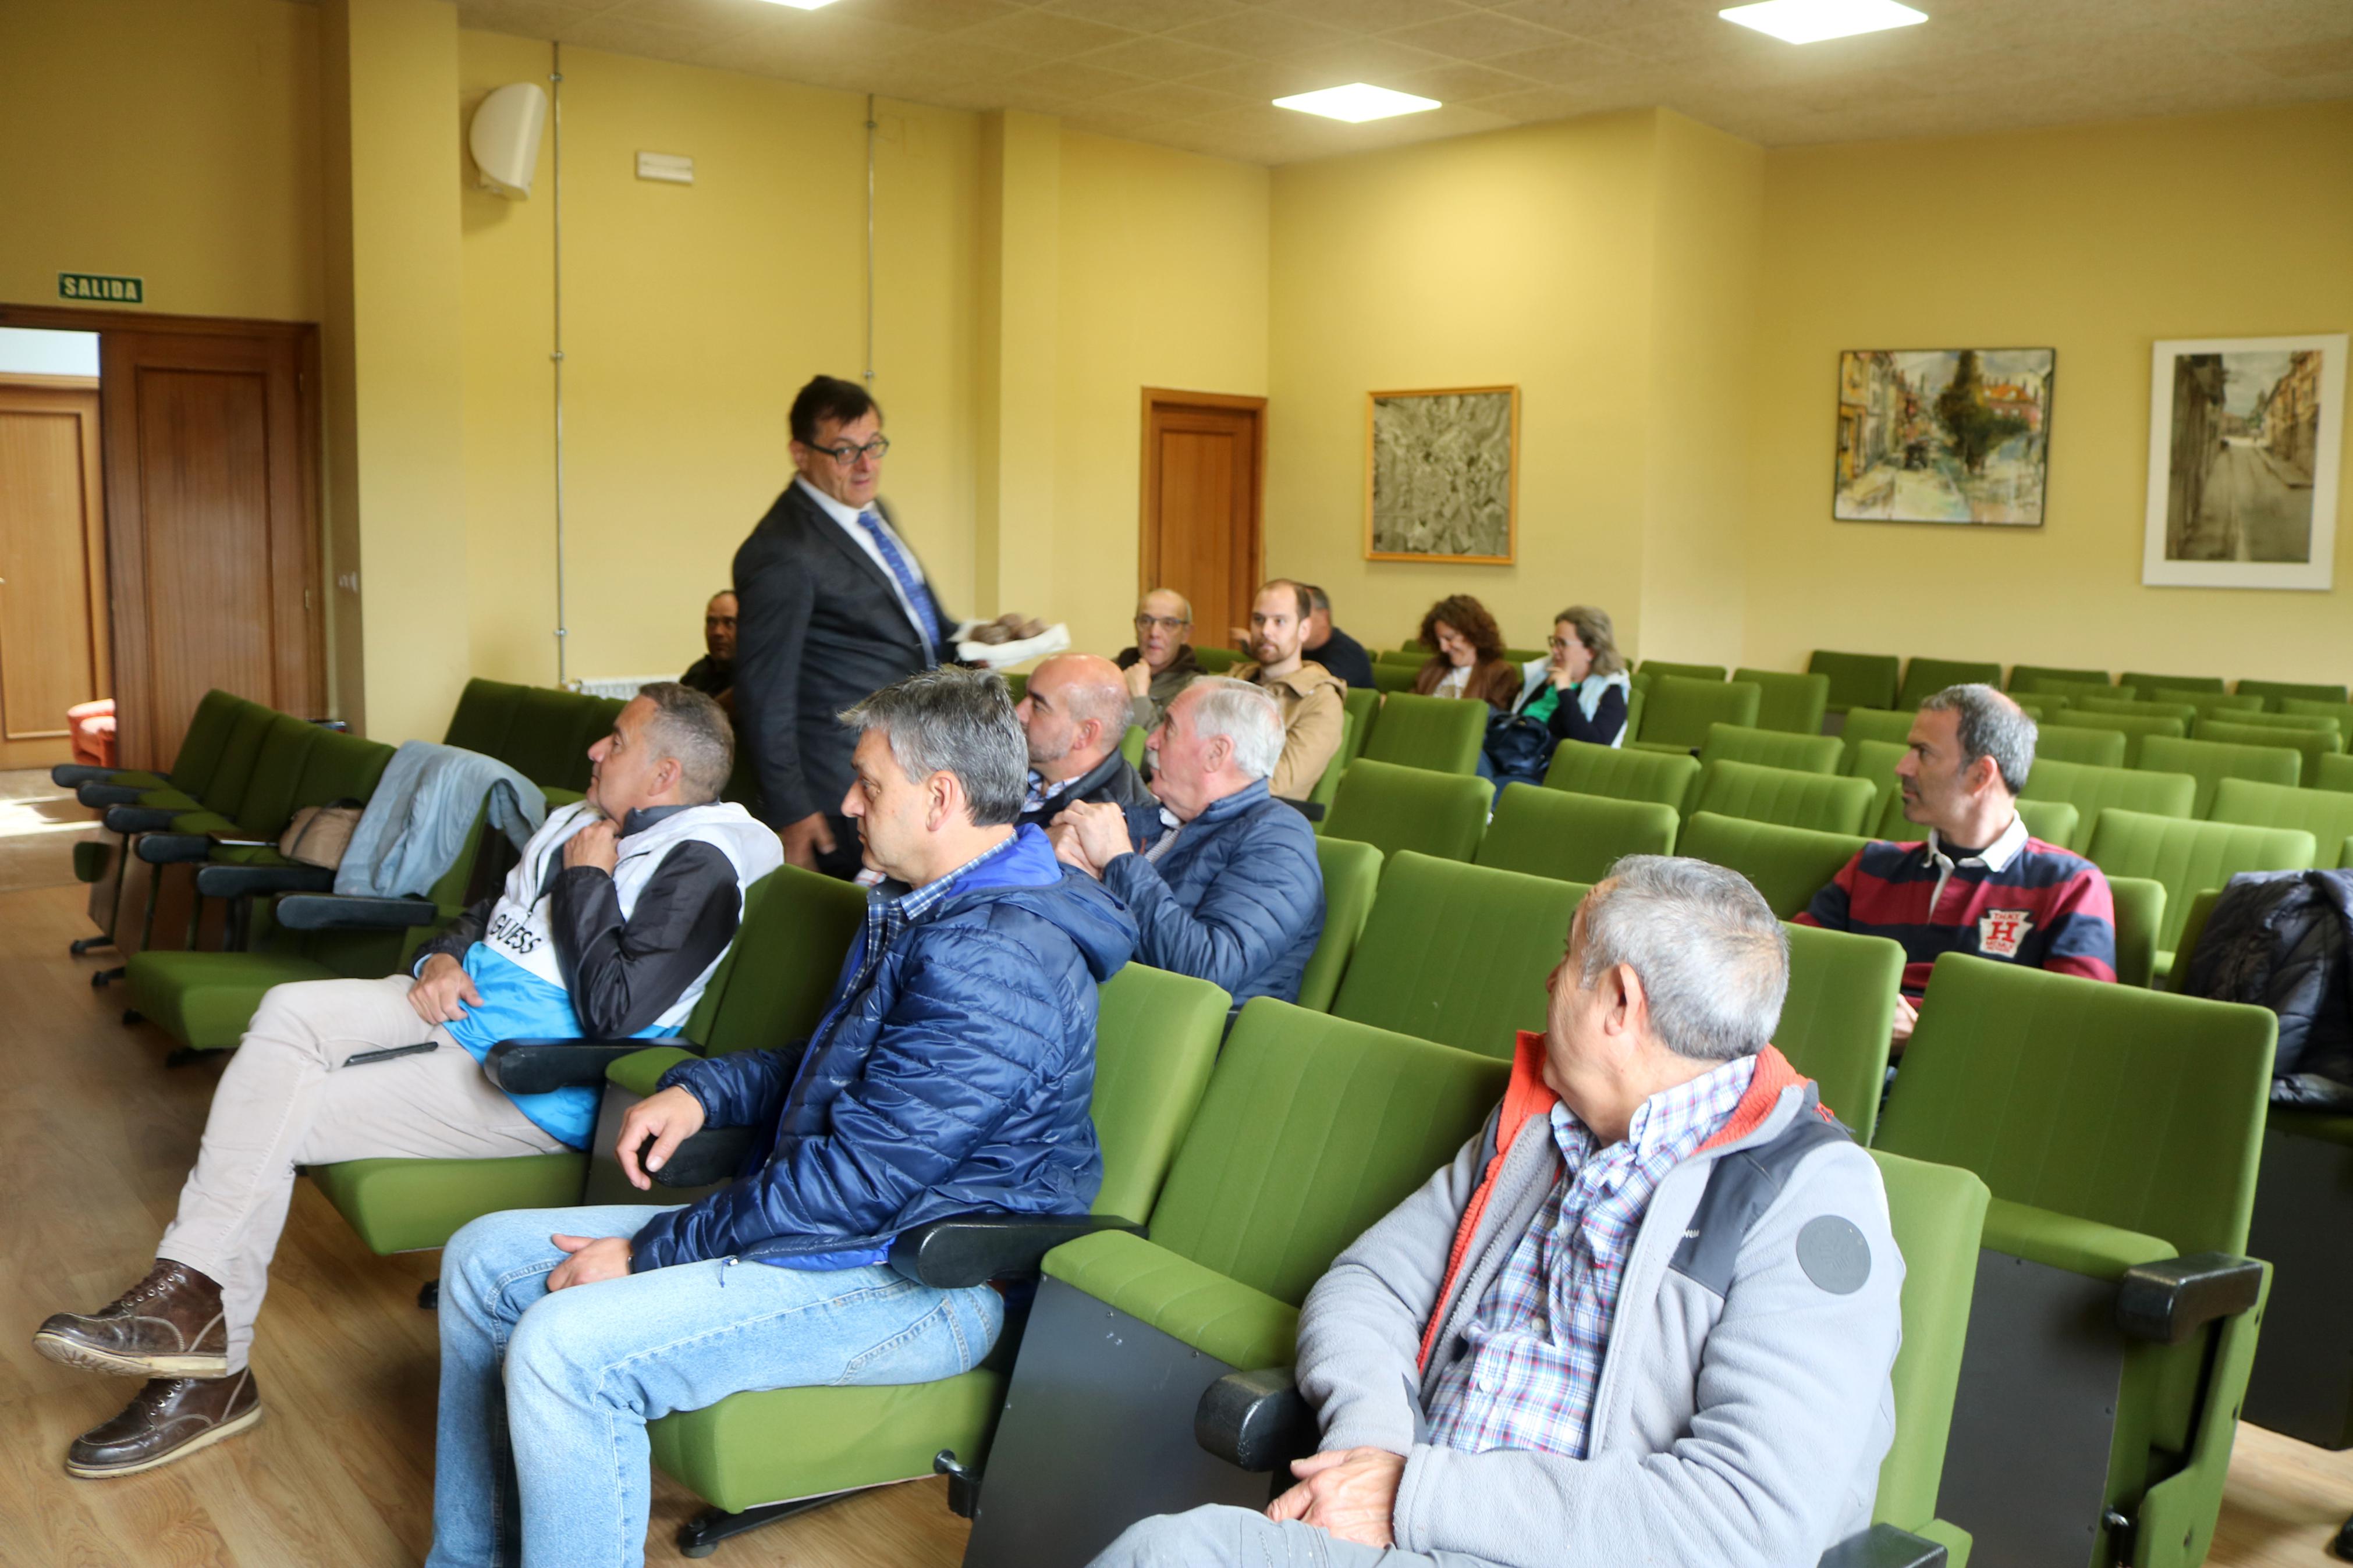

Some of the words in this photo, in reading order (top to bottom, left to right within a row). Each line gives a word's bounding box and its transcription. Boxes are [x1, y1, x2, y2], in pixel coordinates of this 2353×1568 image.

[63, 276, 138, 300] SALIDA
[489, 913, 542, 954] GUESS
[1986, 921, 2020, 943] H
